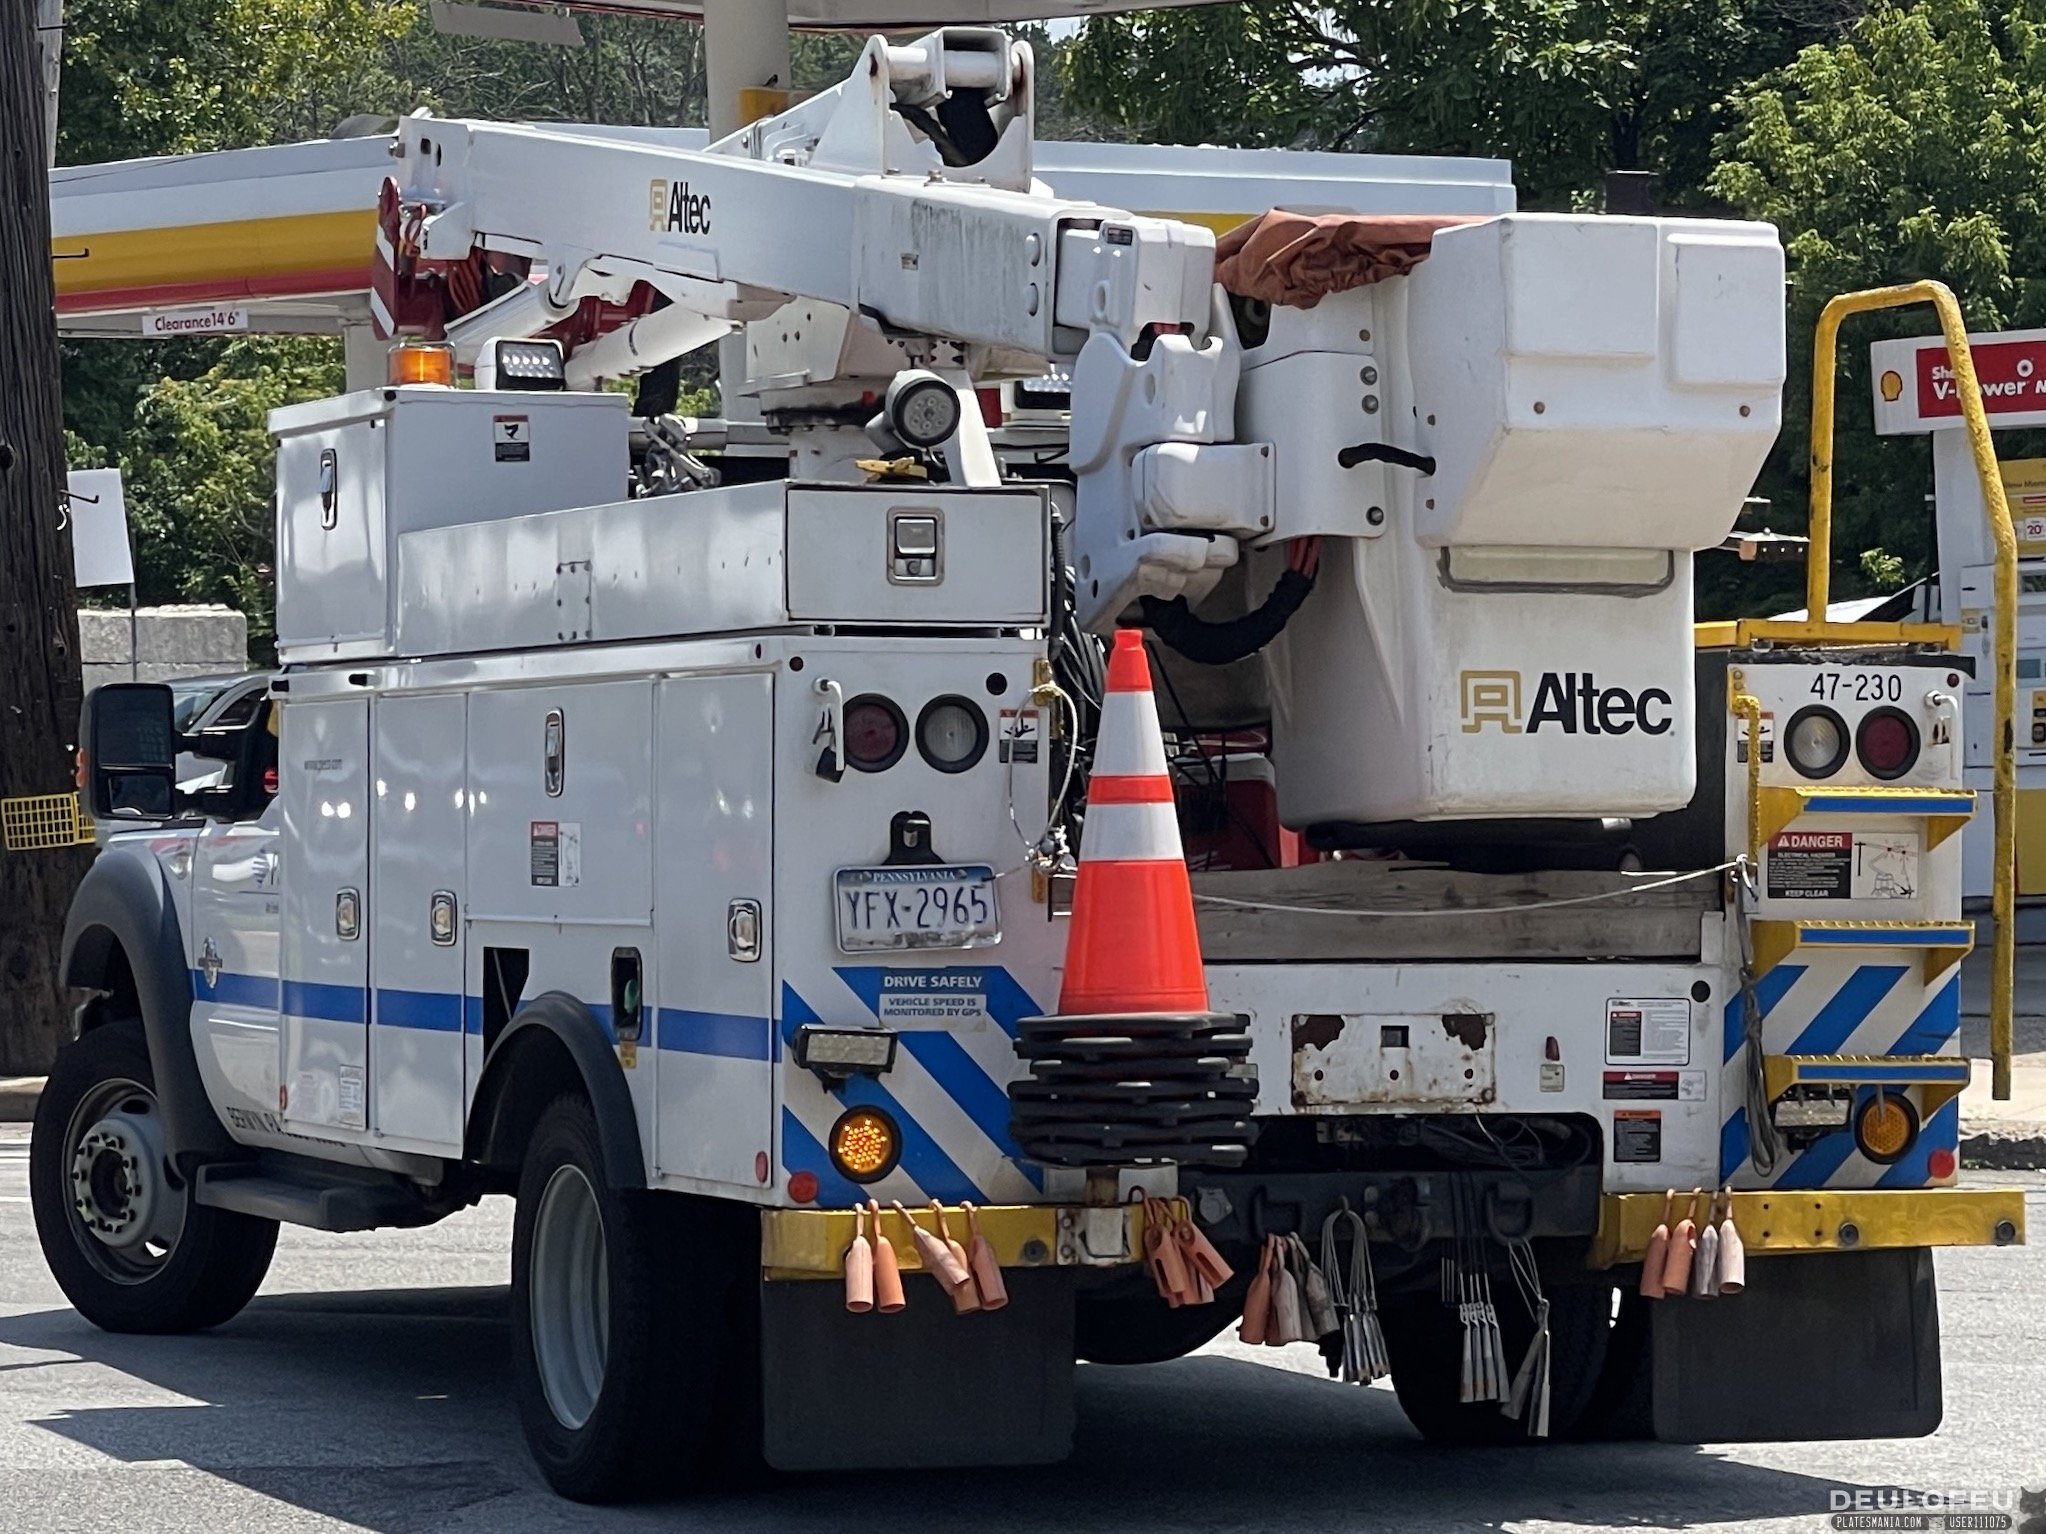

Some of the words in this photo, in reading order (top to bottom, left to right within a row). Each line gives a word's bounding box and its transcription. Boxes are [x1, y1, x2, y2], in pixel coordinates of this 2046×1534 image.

[668, 181, 711, 235] Altec
[1933, 380, 2027, 401] V-wer
[1810, 672, 1902, 702] 47-230
[1526, 672, 1673, 735] Altec
[1791, 835, 1843, 848] DANGER
[873, 871, 956, 883] PENNSYLVANIA
[1785, 889, 1804, 897] KEEP
[1804, 889, 1829, 897] CLEAR
[845, 884, 988, 929] YFX-2965
[884, 976, 927, 988] DRIVE
[930, 976, 982, 988] SAFELY
[888, 998, 929, 1006] VEHICLE
[933, 998, 964, 1006] SPEED
[967, 998, 976, 1006] IS
[883, 1008, 944, 1016] MONITORED
[947, 1008, 959, 1016] BY
[961, 1008, 982, 1017] GPS
